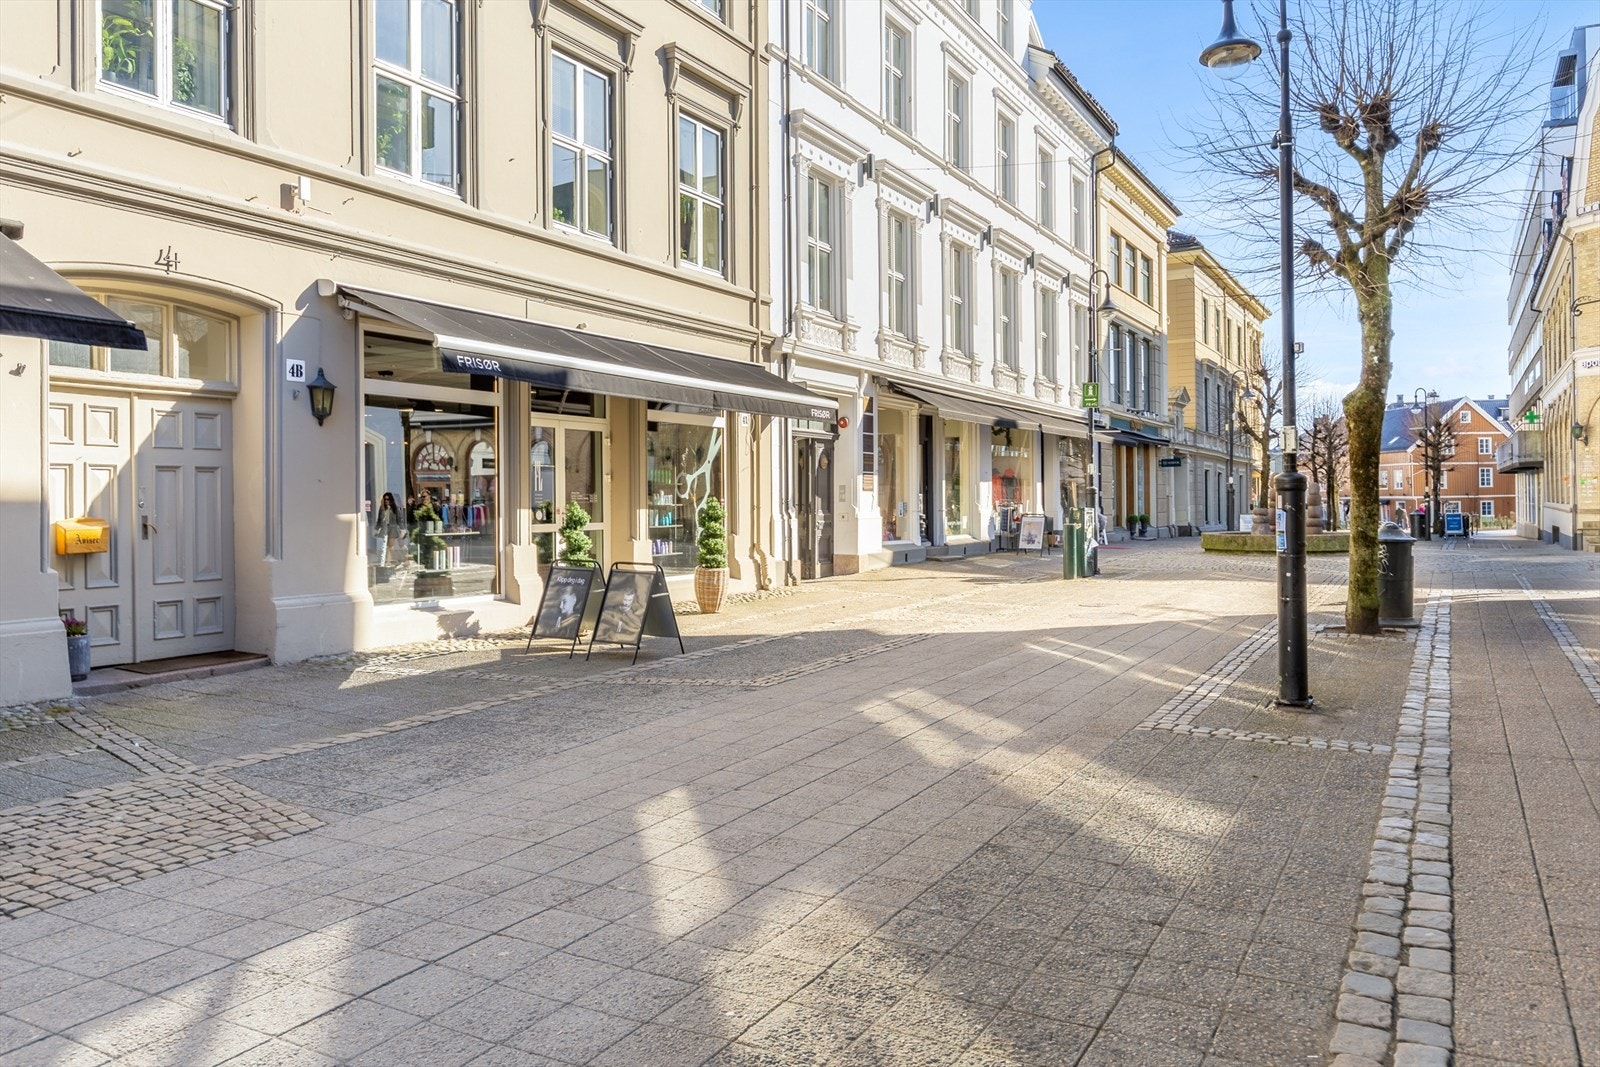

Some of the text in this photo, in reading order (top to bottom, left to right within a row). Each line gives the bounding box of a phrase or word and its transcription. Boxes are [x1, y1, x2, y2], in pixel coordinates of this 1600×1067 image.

[288, 363, 304, 378] 4B
[456, 354, 502, 372] FRISØR
[811, 408, 831, 419] FRISØR
